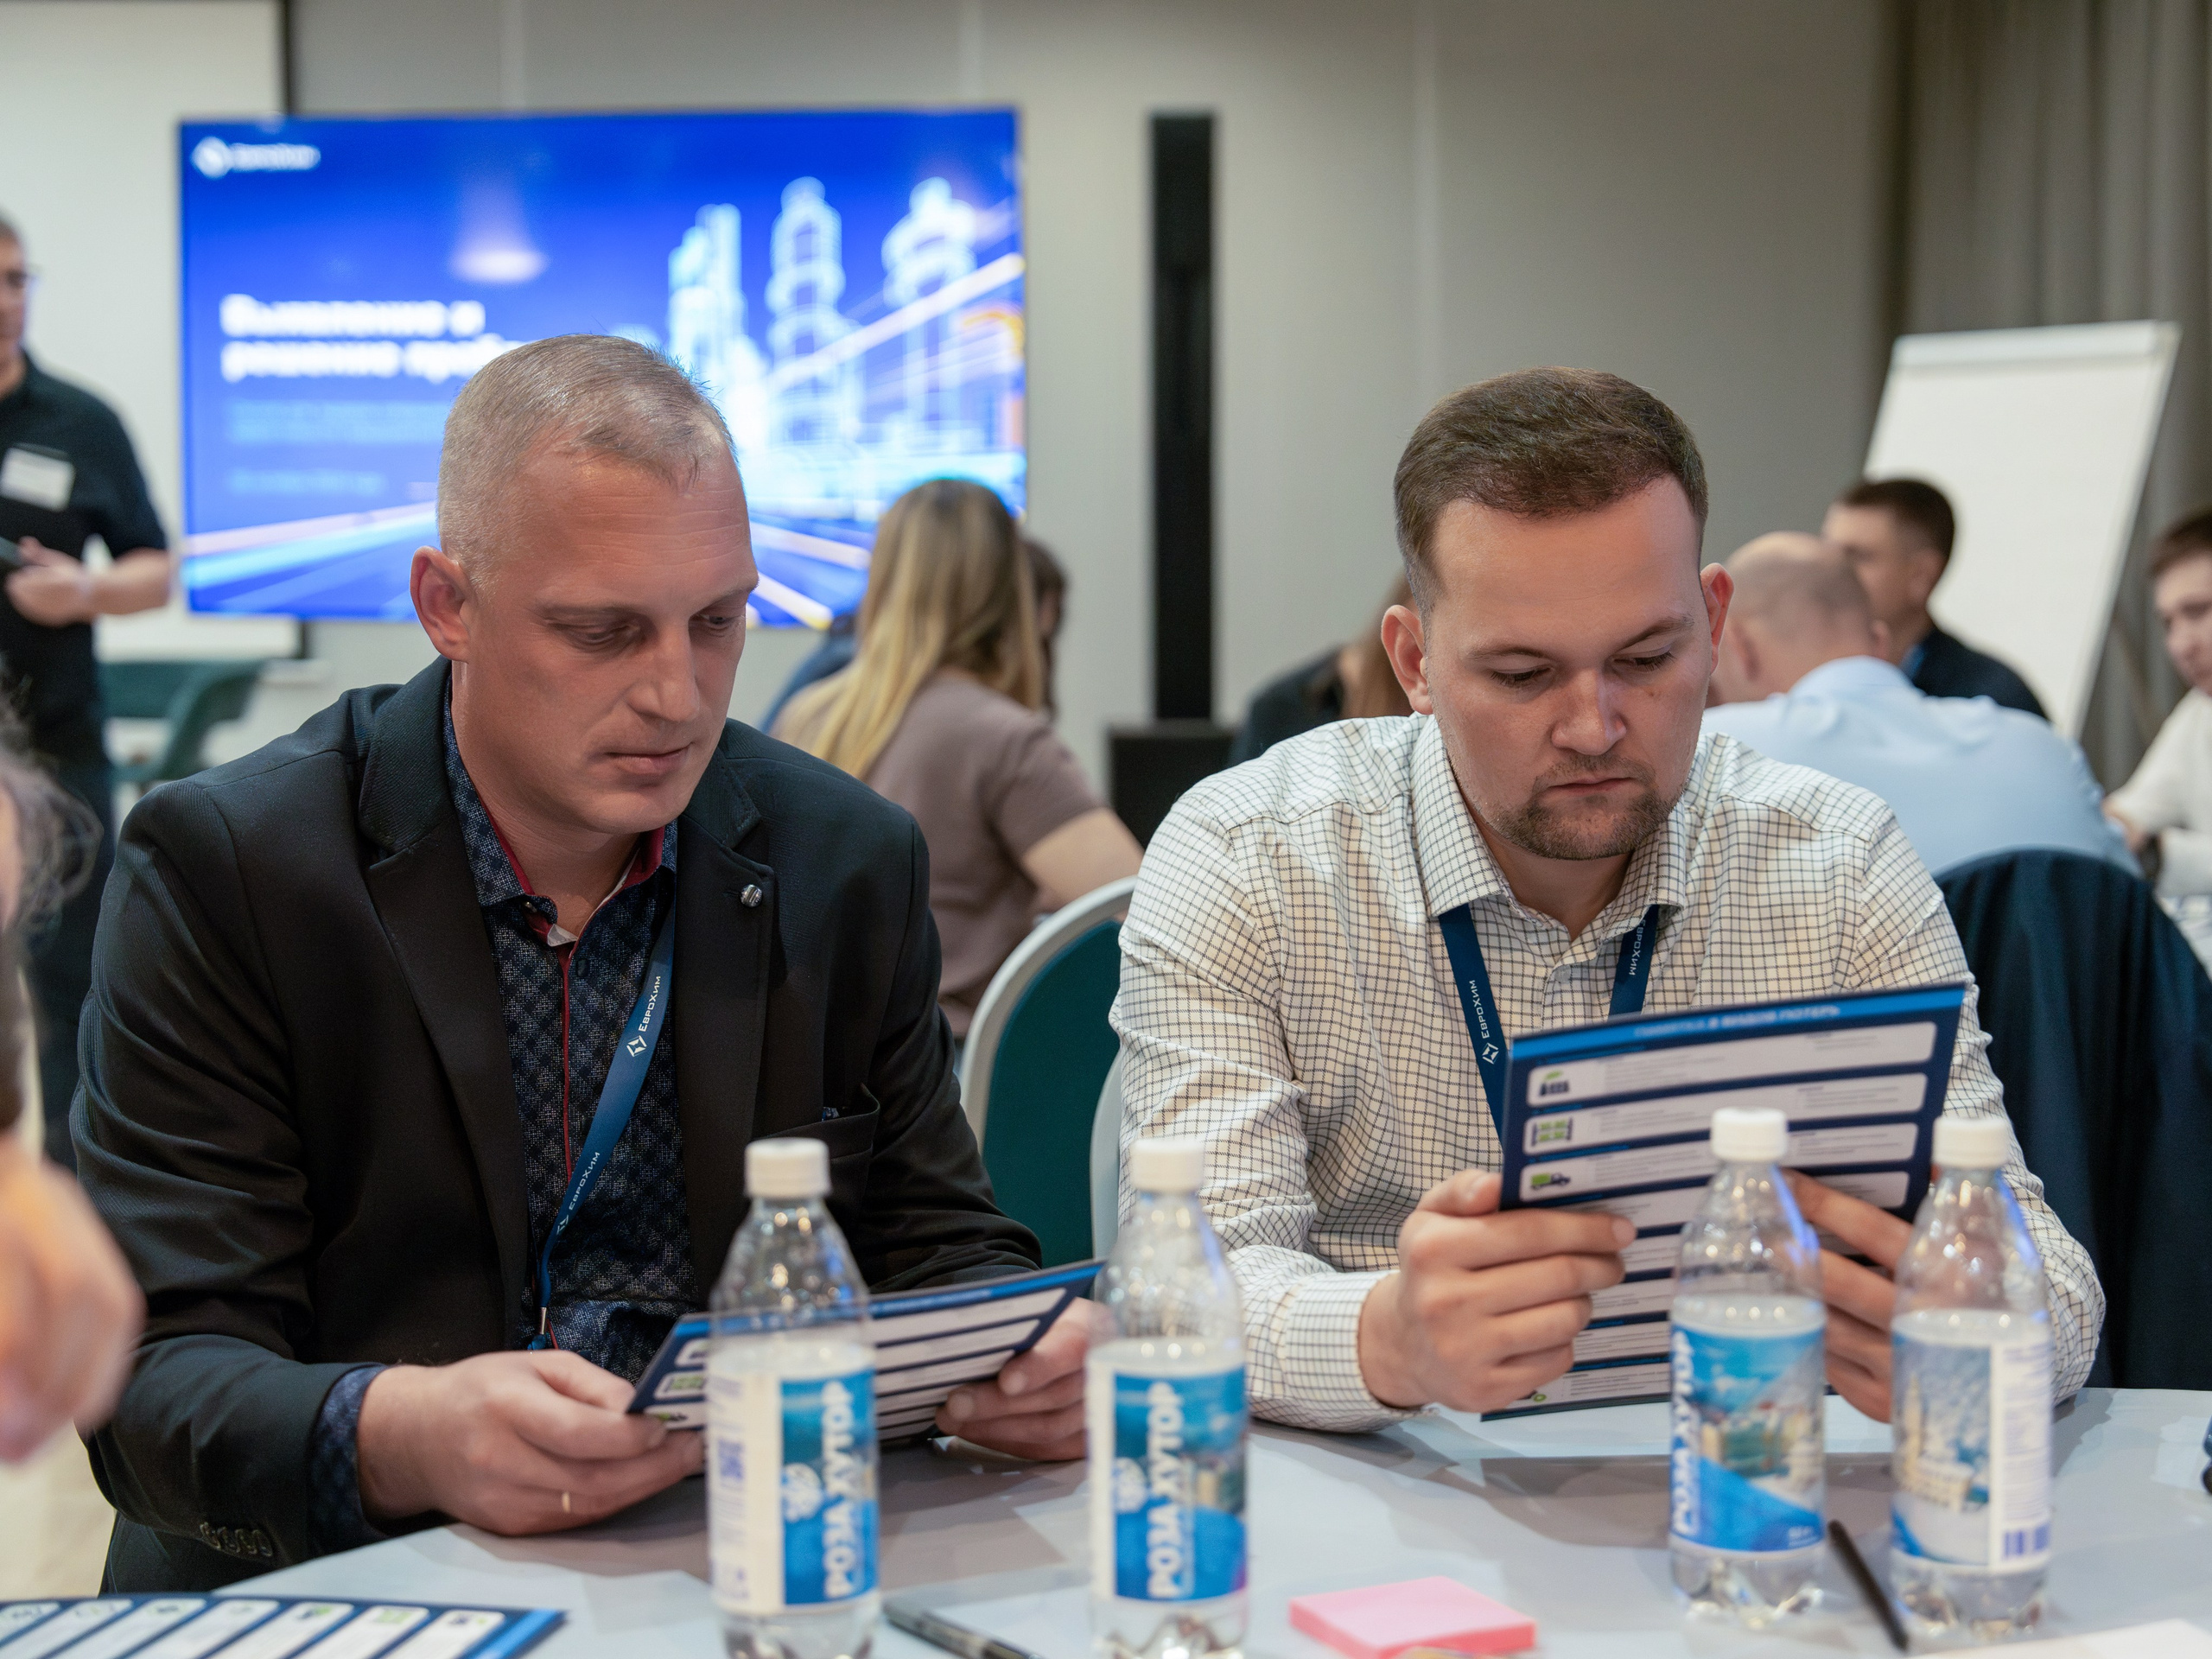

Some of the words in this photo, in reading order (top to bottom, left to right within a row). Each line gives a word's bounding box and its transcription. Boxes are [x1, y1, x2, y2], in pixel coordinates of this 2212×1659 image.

[639, 976, 661, 1033] ЕВРОХИМ
[1469, 980, 1491, 1039] ЕВРОХИМ
[569, 1152, 601, 1211] ЕВРОХИМ
